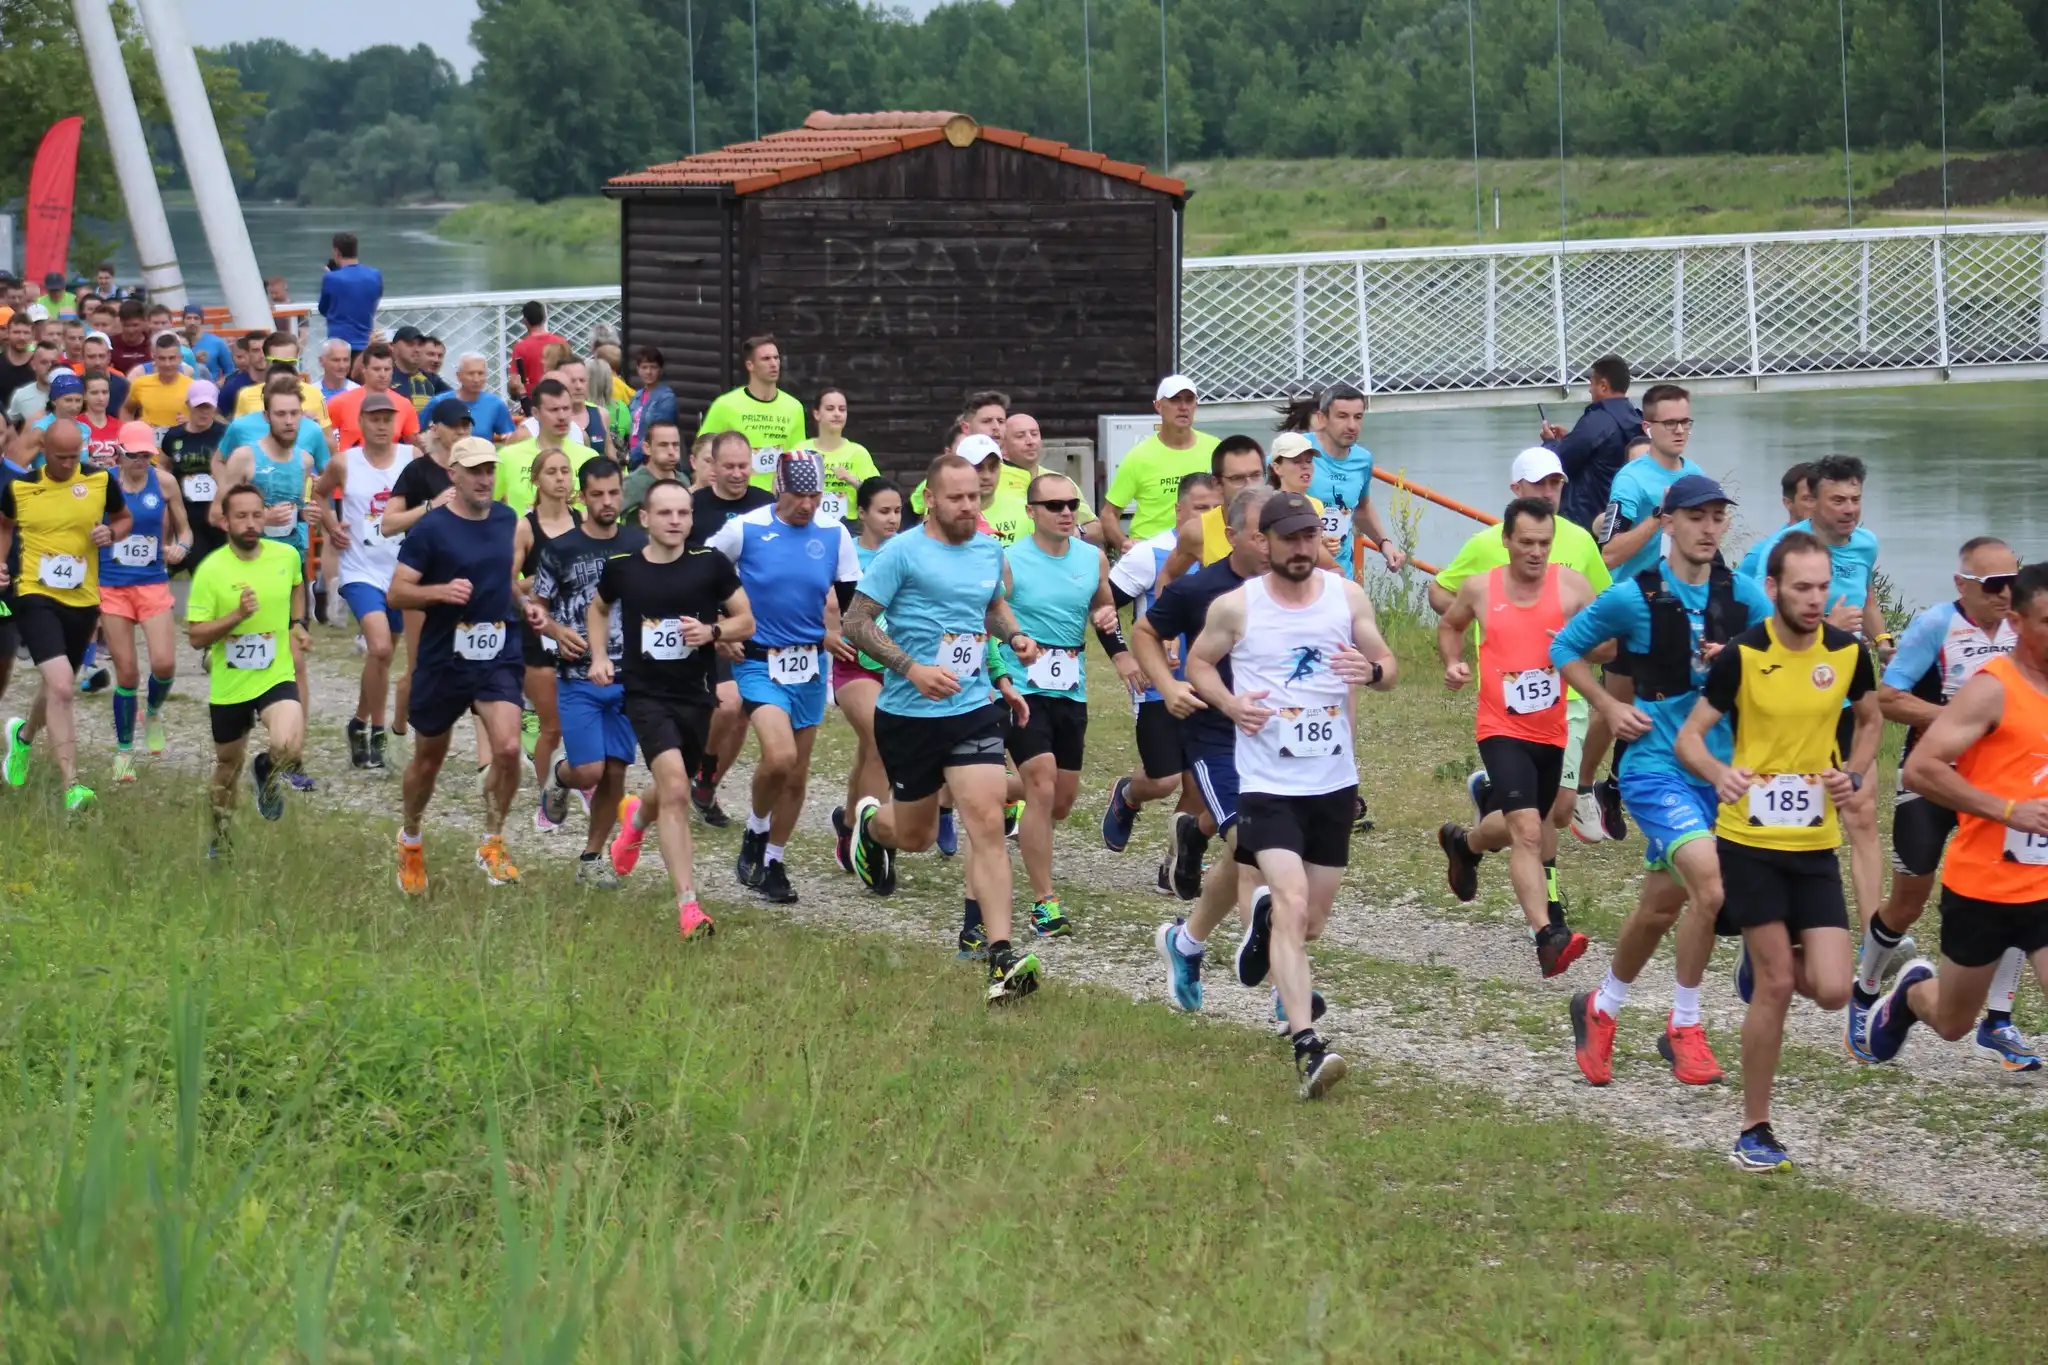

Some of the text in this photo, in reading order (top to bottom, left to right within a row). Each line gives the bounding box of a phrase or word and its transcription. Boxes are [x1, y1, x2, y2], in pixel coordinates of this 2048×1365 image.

[826, 238, 1055, 288] DRAVA
[760, 454, 775, 466] 68
[195, 482, 210, 493] 53
[995, 520, 1017, 532] V&V
[123, 544, 149, 557] 163
[53, 564, 73, 578] 44
[467, 633, 498, 649] 160
[235, 643, 266, 659] 271
[951, 646, 972, 664] 96
[778, 655, 809, 673] 120
[1050, 661, 1061, 677] 6
[1515, 679, 1552, 701] 153
[1294, 721, 1333, 742] 186
[1765, 790, 1809, 811] 185
